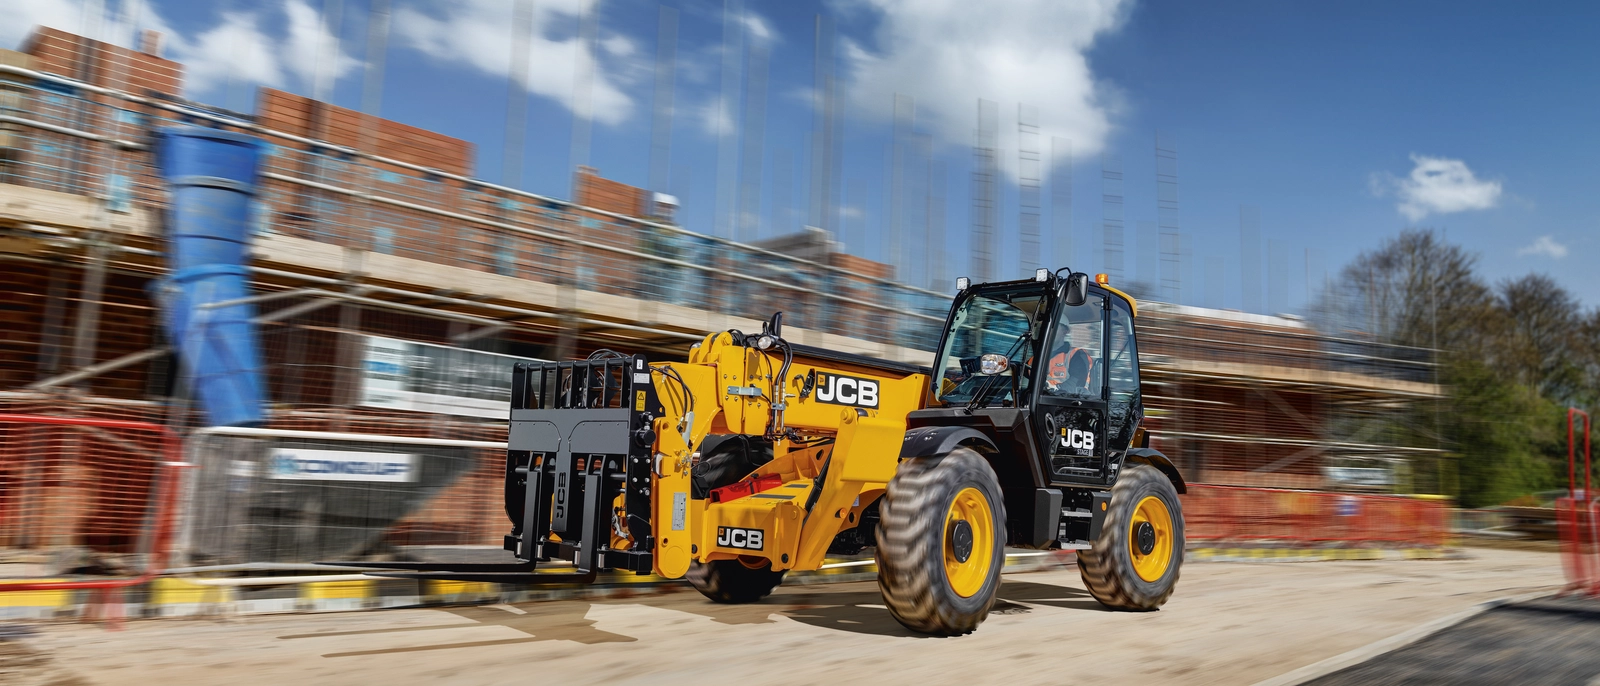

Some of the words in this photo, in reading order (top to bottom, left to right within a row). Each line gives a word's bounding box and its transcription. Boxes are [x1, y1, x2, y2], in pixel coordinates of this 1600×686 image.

[817, 376, 878, 407] JCB
[1061, 428, 1095, 450] JCB
[556, 472, 567, 518] JCB
[718, 529, 763, 549] JCB
